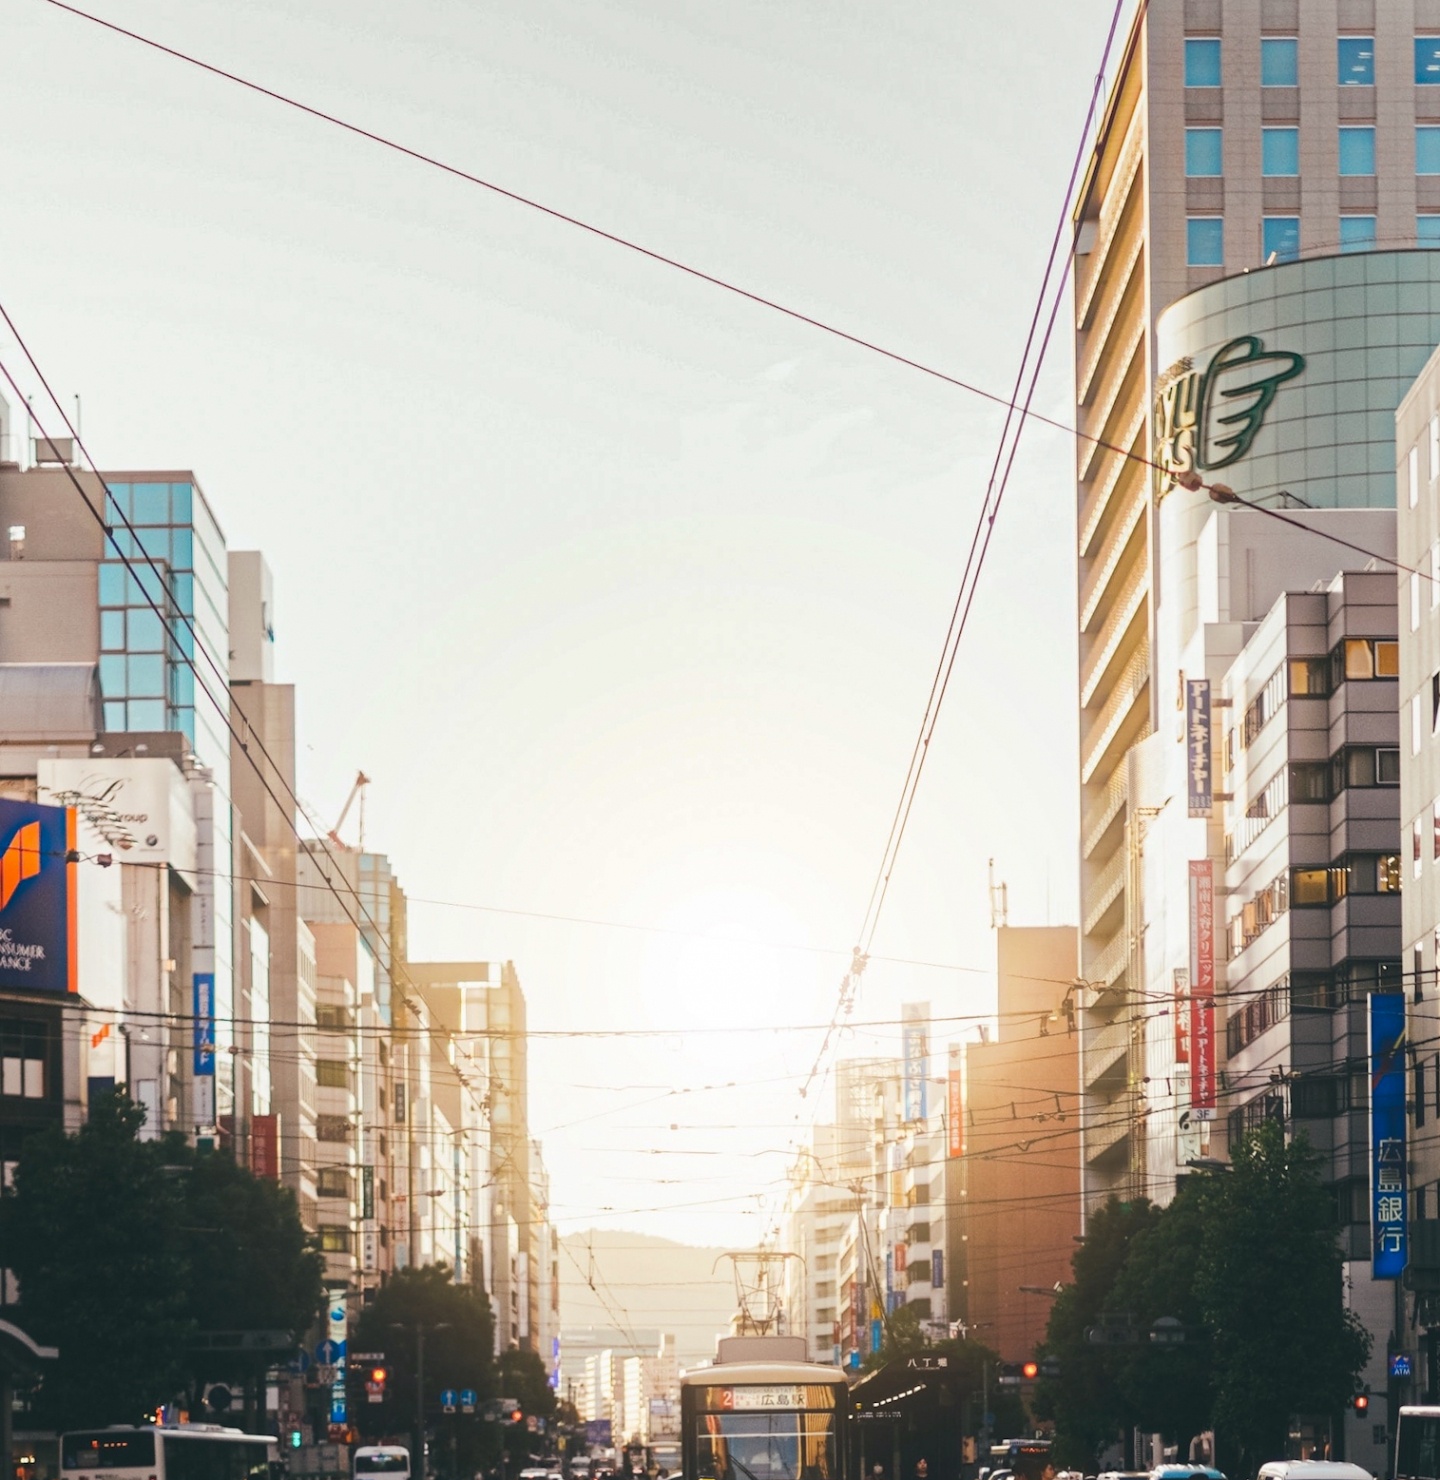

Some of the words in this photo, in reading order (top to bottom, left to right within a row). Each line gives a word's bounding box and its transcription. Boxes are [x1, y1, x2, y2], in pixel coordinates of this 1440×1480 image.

[1190, 682, 1208, 794] アートネイチャー
[1198, 876, 1213, 985] 湘南美容クリニック
[1196, 1109, 1210, 1119] 3F
[1378, 1137, 1402, 1253] 広島銀行
[907, 1357, 948, 1367] 八丁堀
[1394, 1368, 1411, 1376] ATM
[723, 1391, 732, 1406] 2
[761, 1393, 806, 1406] 広島駅
